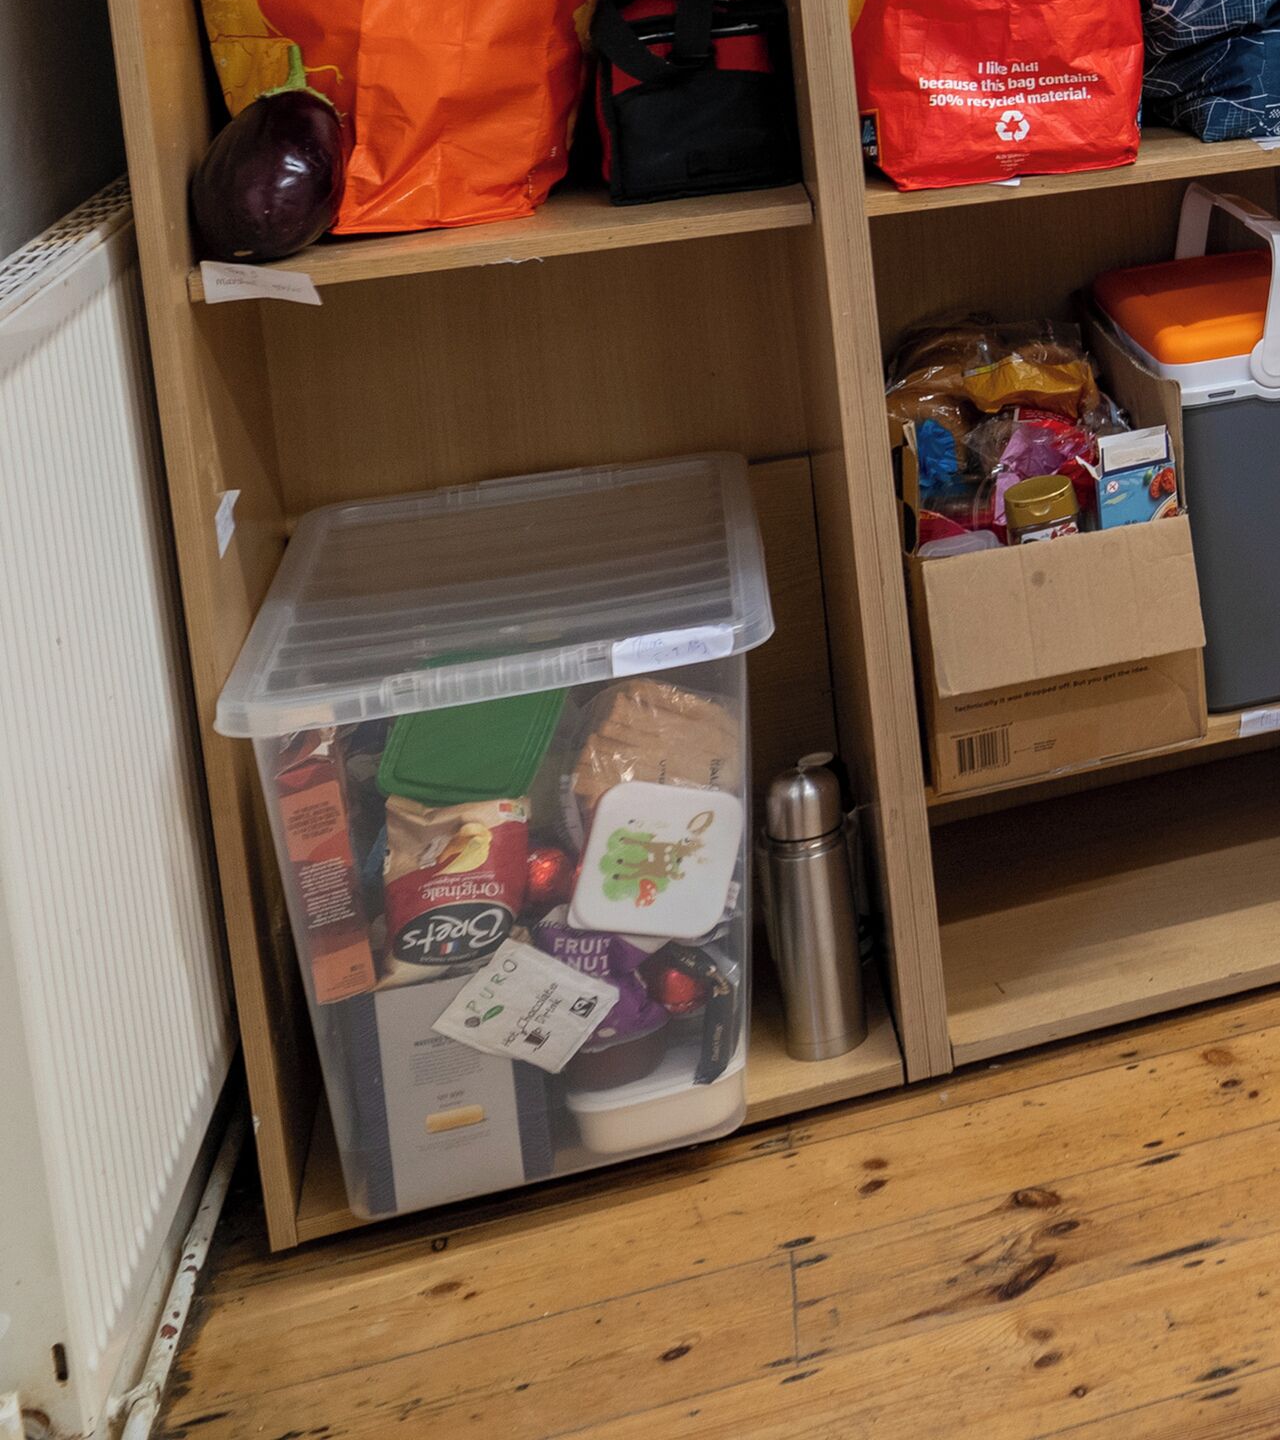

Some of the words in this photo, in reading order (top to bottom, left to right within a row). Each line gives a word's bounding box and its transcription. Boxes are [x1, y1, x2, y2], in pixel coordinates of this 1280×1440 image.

[919, 77, 977, 91] because
[981, 79, 1005, 92] this
[1008, 77, 1034, 90] bag
[1039, 73, 1098, 86] contains
[978, 62, 983, 74] I
[986, 61, 1008, 74] like
[1011, 62, 1038, 73] Aldi
[929, 94, 964, 106] 50%
[967, 93, 1024, 109] recycled
[1027, 87, 1091, 104] material.
[954, 699, 998, 712] Technically
[1024, 685, 1057, 697] dropped
[1059, 682, 1070, 690] off.
[1088, 677, 1101, 685] you
[1103, 672, 1116, 681] get
[1118, 669, 1129, 677] the
[402, 908, 504, 953] Brets
[466, 959, 517, 1013] PURO
[516, 982, 559, 1031] Chocolate
[535, 997, 562, 1024] Drink
